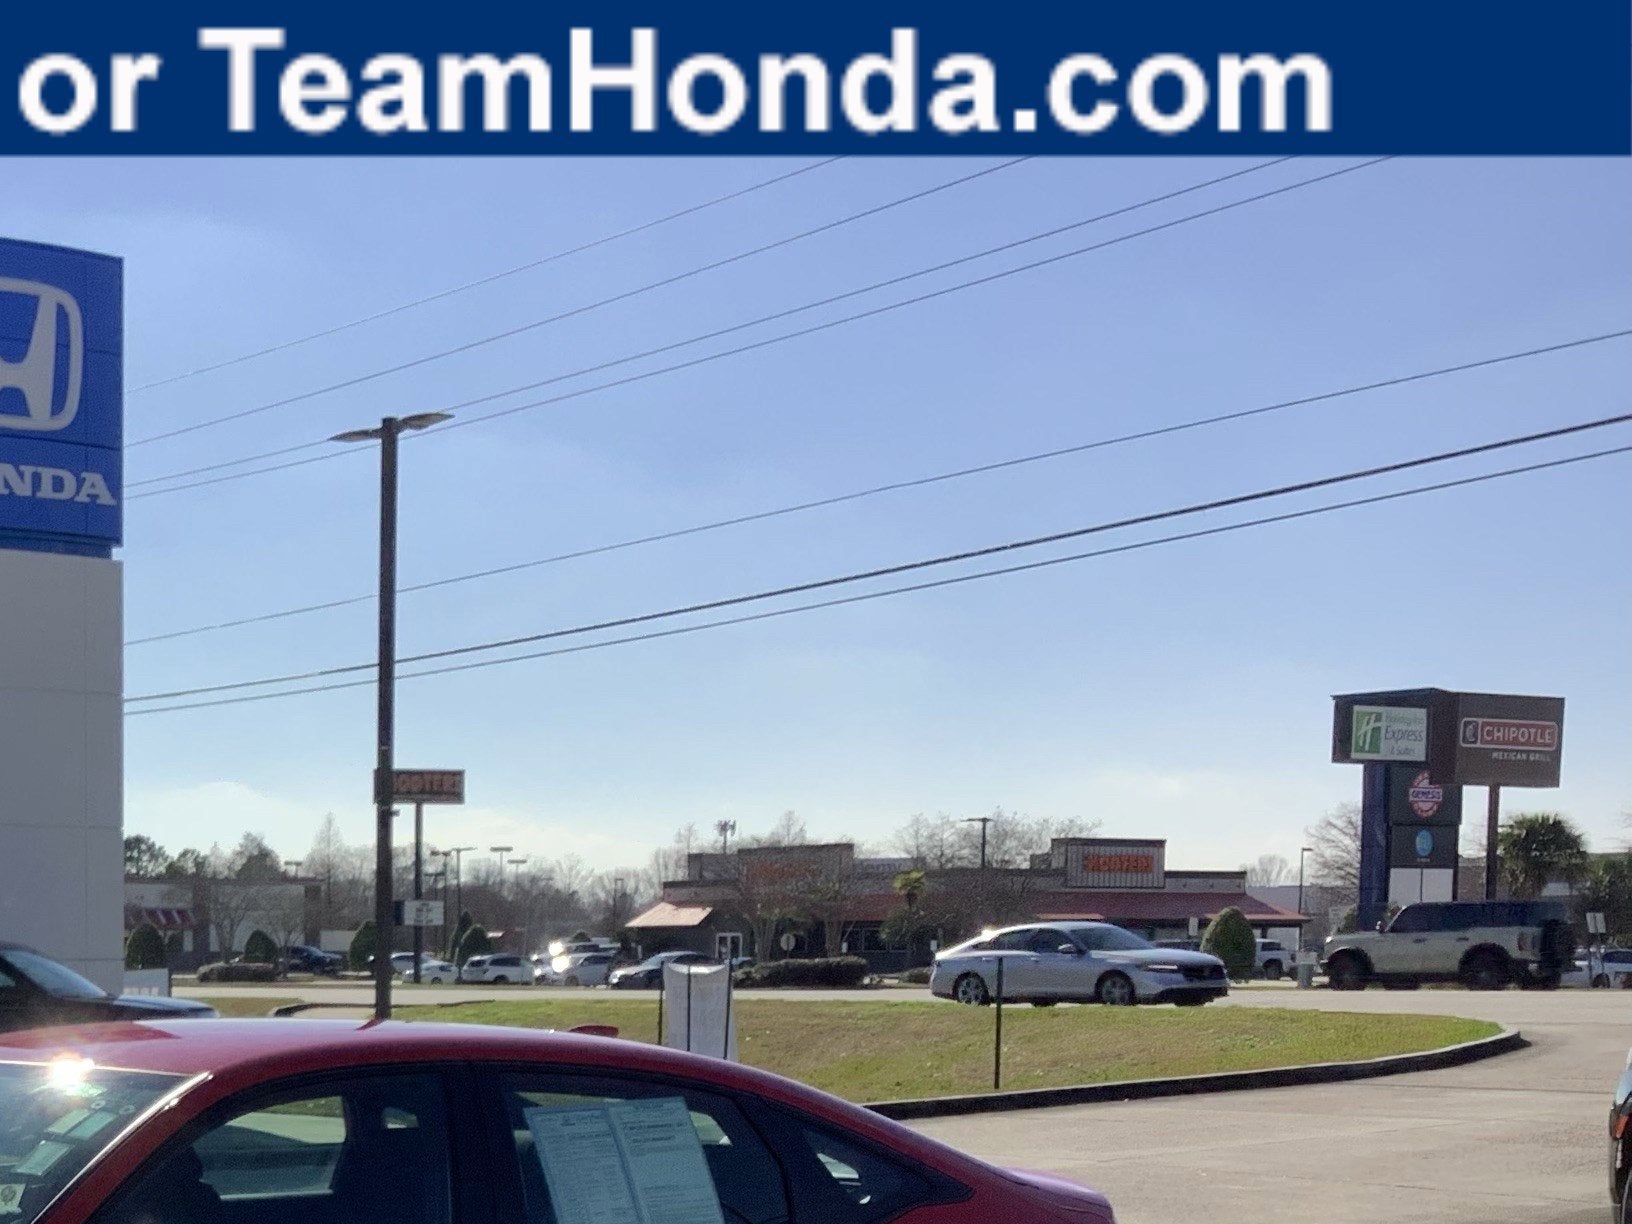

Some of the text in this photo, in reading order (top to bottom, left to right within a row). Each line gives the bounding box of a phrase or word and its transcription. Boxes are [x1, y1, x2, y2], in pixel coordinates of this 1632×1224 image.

[1385, 725, 1424, 742] Express
[1483, 726, 1554, 743] CHIPOTLE
[1491, 751, 1527, 761] MEXICAN
[392, 774, 463, 794] OOTERS
